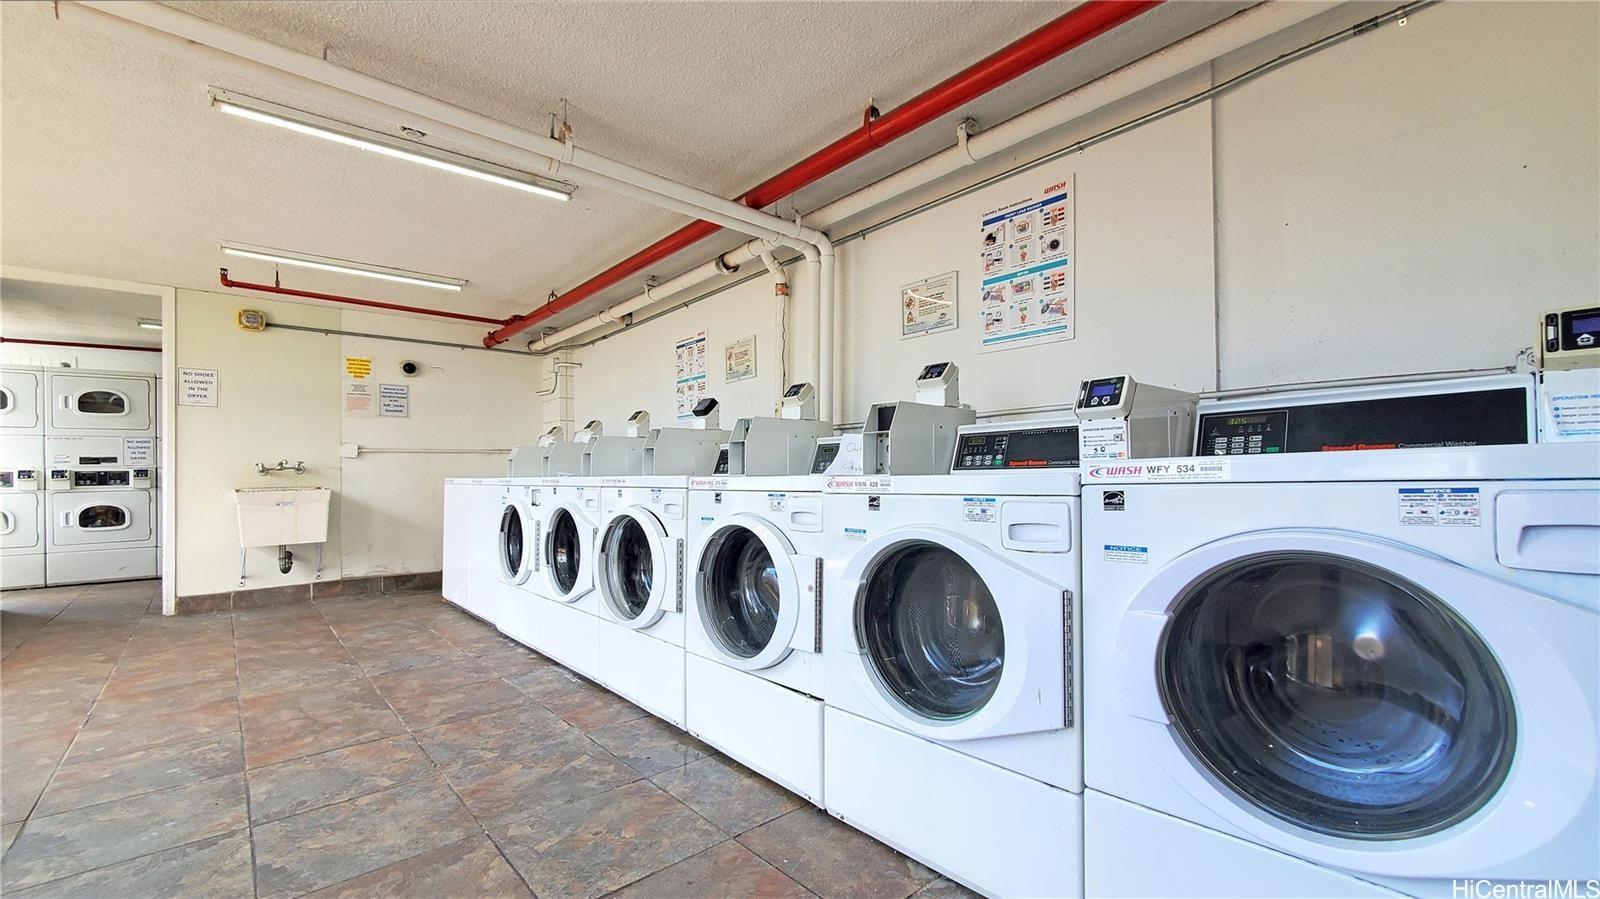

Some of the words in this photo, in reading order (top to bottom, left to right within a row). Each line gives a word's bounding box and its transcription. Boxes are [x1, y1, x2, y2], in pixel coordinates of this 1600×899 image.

[1043, 181, 1067, 194] WASH
[1398, 441, 1444, 449] Commercial
[1445, 439, 1478, 448] Washer
[1106, 466, 1142, 476] WASH
[1146, 465, 1171, 474] WFY
[1176, 464, 1196, 473] 534
[835, 480, 854, 488] WASH
